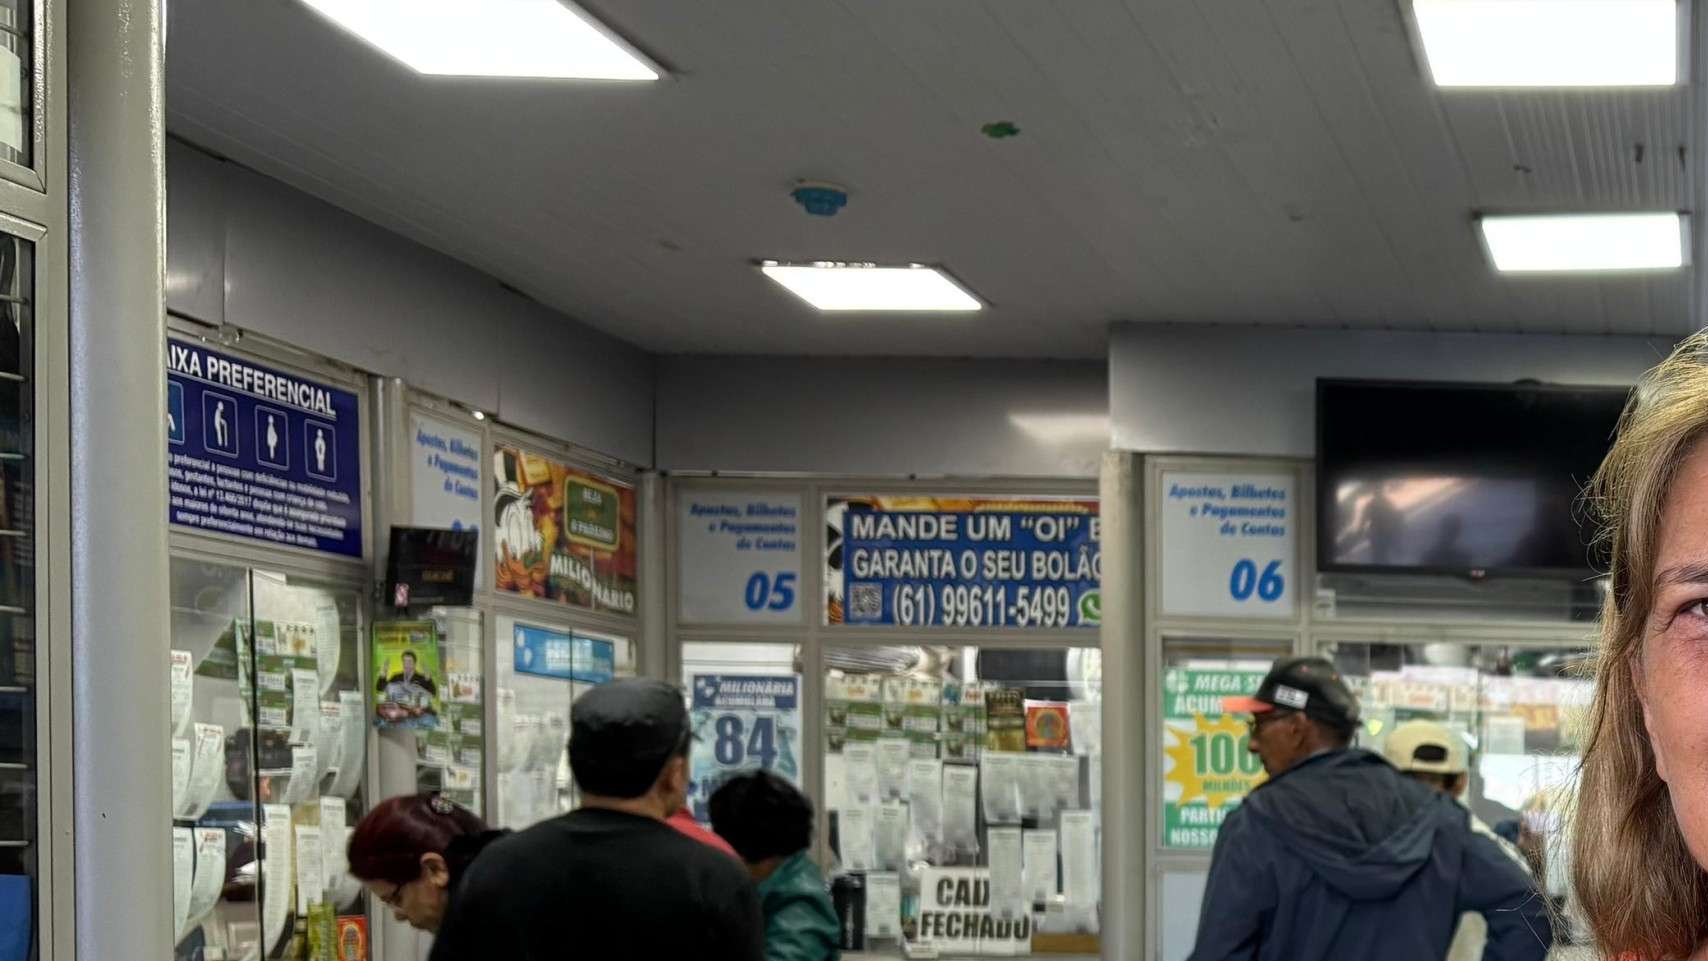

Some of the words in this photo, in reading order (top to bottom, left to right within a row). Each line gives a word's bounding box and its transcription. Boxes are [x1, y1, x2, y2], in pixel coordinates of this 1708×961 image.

[207, 356, 337, 415] PREFERENCIAL
[1169, 484, 1227, 500] Apostas,
[1231, 484, 1286, 499] Bilhetes
[1202, 503, 1286, 519] Pagamentos
[719, 520, 796, 534] Pagamentos
[852, 514, 958, 540] MANDE
[967, 516, 1010, 540] UM
[1220, 520, 1236, 535] de
[1241, 521, 1286, 537] Contas
[755, 537, 796, 552] Contas
[853, 550, 957, 578] GARANTA
[961, 550, 977, 579] O
[983, 551, 1026, 580] SEU
[744, 571, 797, 612] 05
[1230, 559, 1285, 602] 06
[893, 584, 935, 625] (61)
[942, 584, 1070, 626] 99611-5499
[1195, 674, 1242, 691] MEGA
[714, 714, 778, 769] 84
[936, 877, 990, 907] CAI
